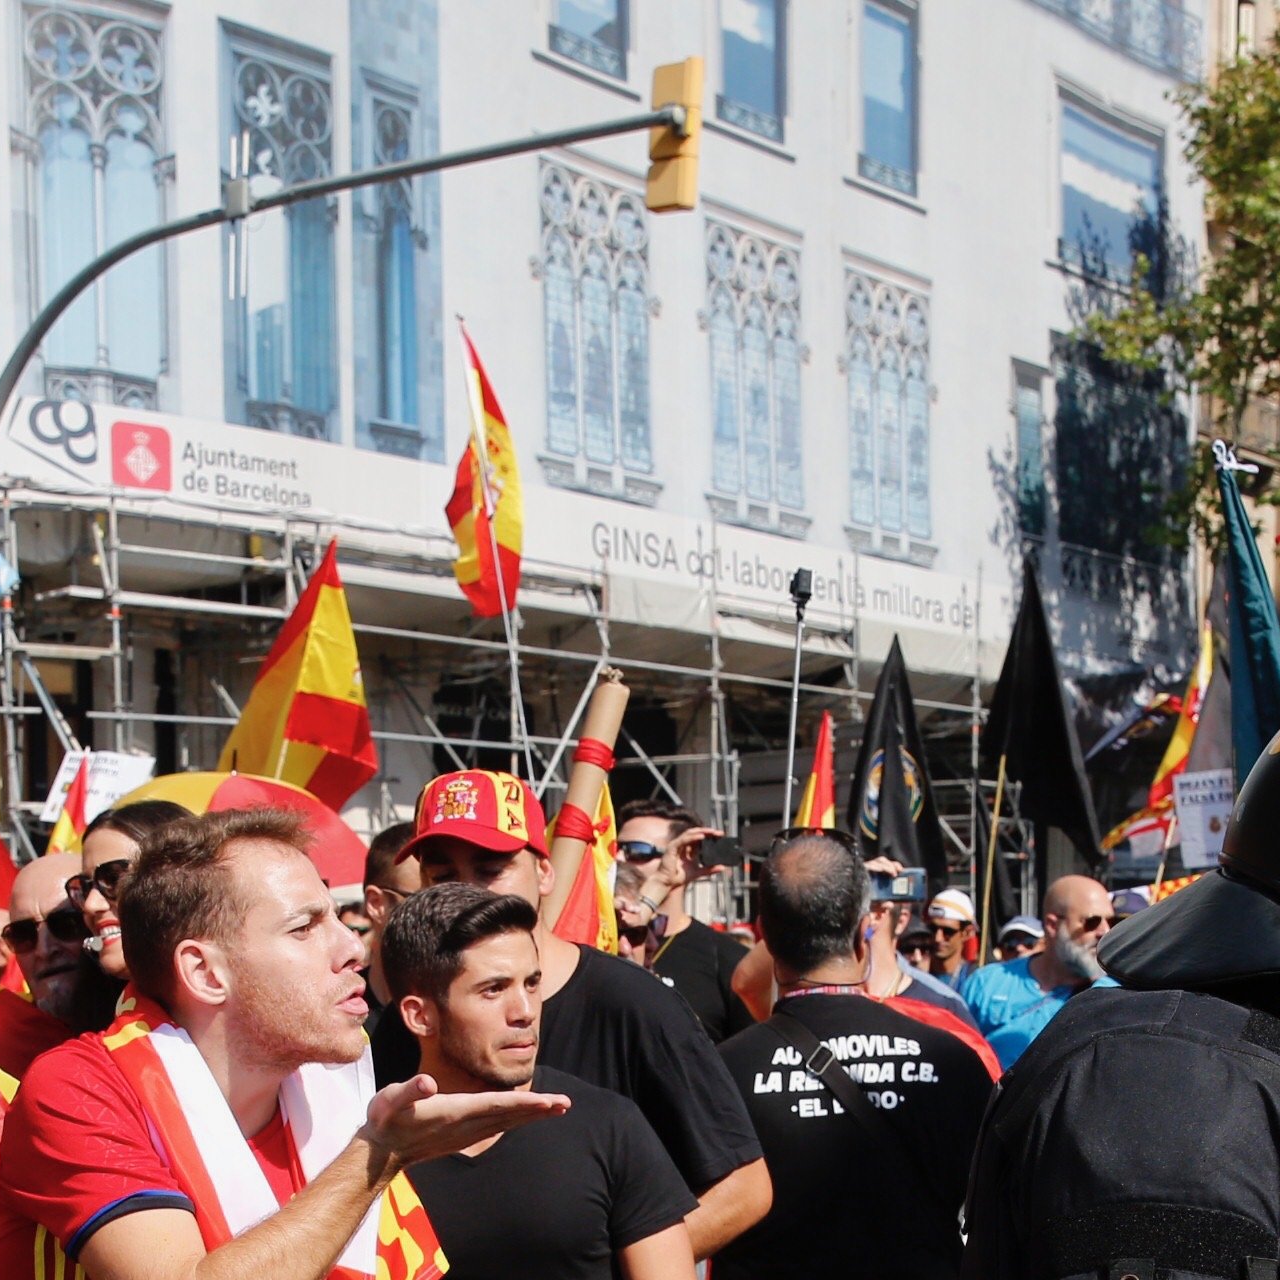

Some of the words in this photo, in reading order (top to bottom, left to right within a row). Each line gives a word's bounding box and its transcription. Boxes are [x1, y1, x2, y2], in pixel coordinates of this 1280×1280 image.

[182, 441, 299, 480] Ajuntament
[182, 472, 209, 494] de
[215, 473, 312, 508] Barcelona
[591, 522, 680, 572] GINSA
[685, 547, 800, 592] col·labor
[873, 584, 945, 620] millora
[771, 1034, 922, 1066] AUMOVILES
[753, 1071, 783, 1094] LA
[788, 1062, 896, 1092] RENDA
[900, 1061, 939, 1083] C.B.
